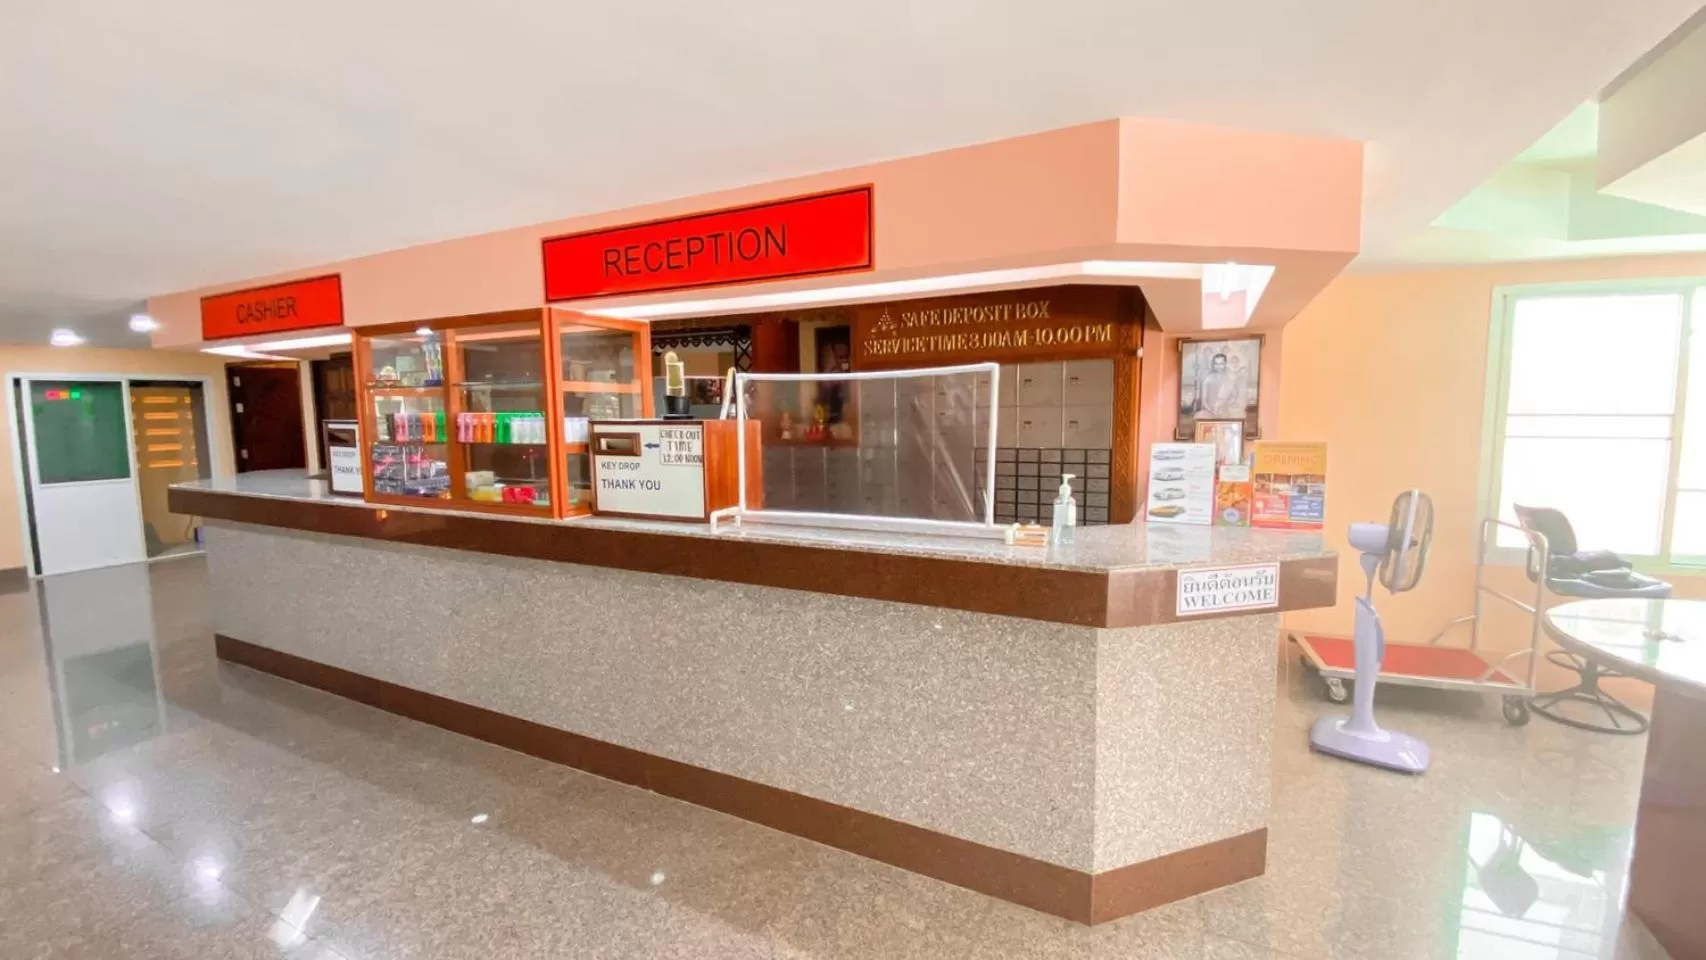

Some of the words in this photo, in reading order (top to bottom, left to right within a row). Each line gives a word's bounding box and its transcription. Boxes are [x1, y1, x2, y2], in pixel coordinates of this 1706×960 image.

[603, 224, 788, 278] RECEPTION
[235, 296, 298, 324] CASHIER
[900, 308, 941, 329] SAFE
[942, 302, 1012, 326] DEPOSIT
[1015, 299, 1051, 320] BOX
[863, 335, 926, 357] SERVICE
[926, 332, 968, 353] TIME
[668, 441, 692, 453] TIME
[601, 462, 617, 471] KEY
[618, 462, 641, 471] DROP
[1263, 454, 1319, 467] OPENING
[601, 478, 636, 490] THANK
[639, 479, 661, 491] YOU
[1184, 589, 1274, 609] WELCOME
